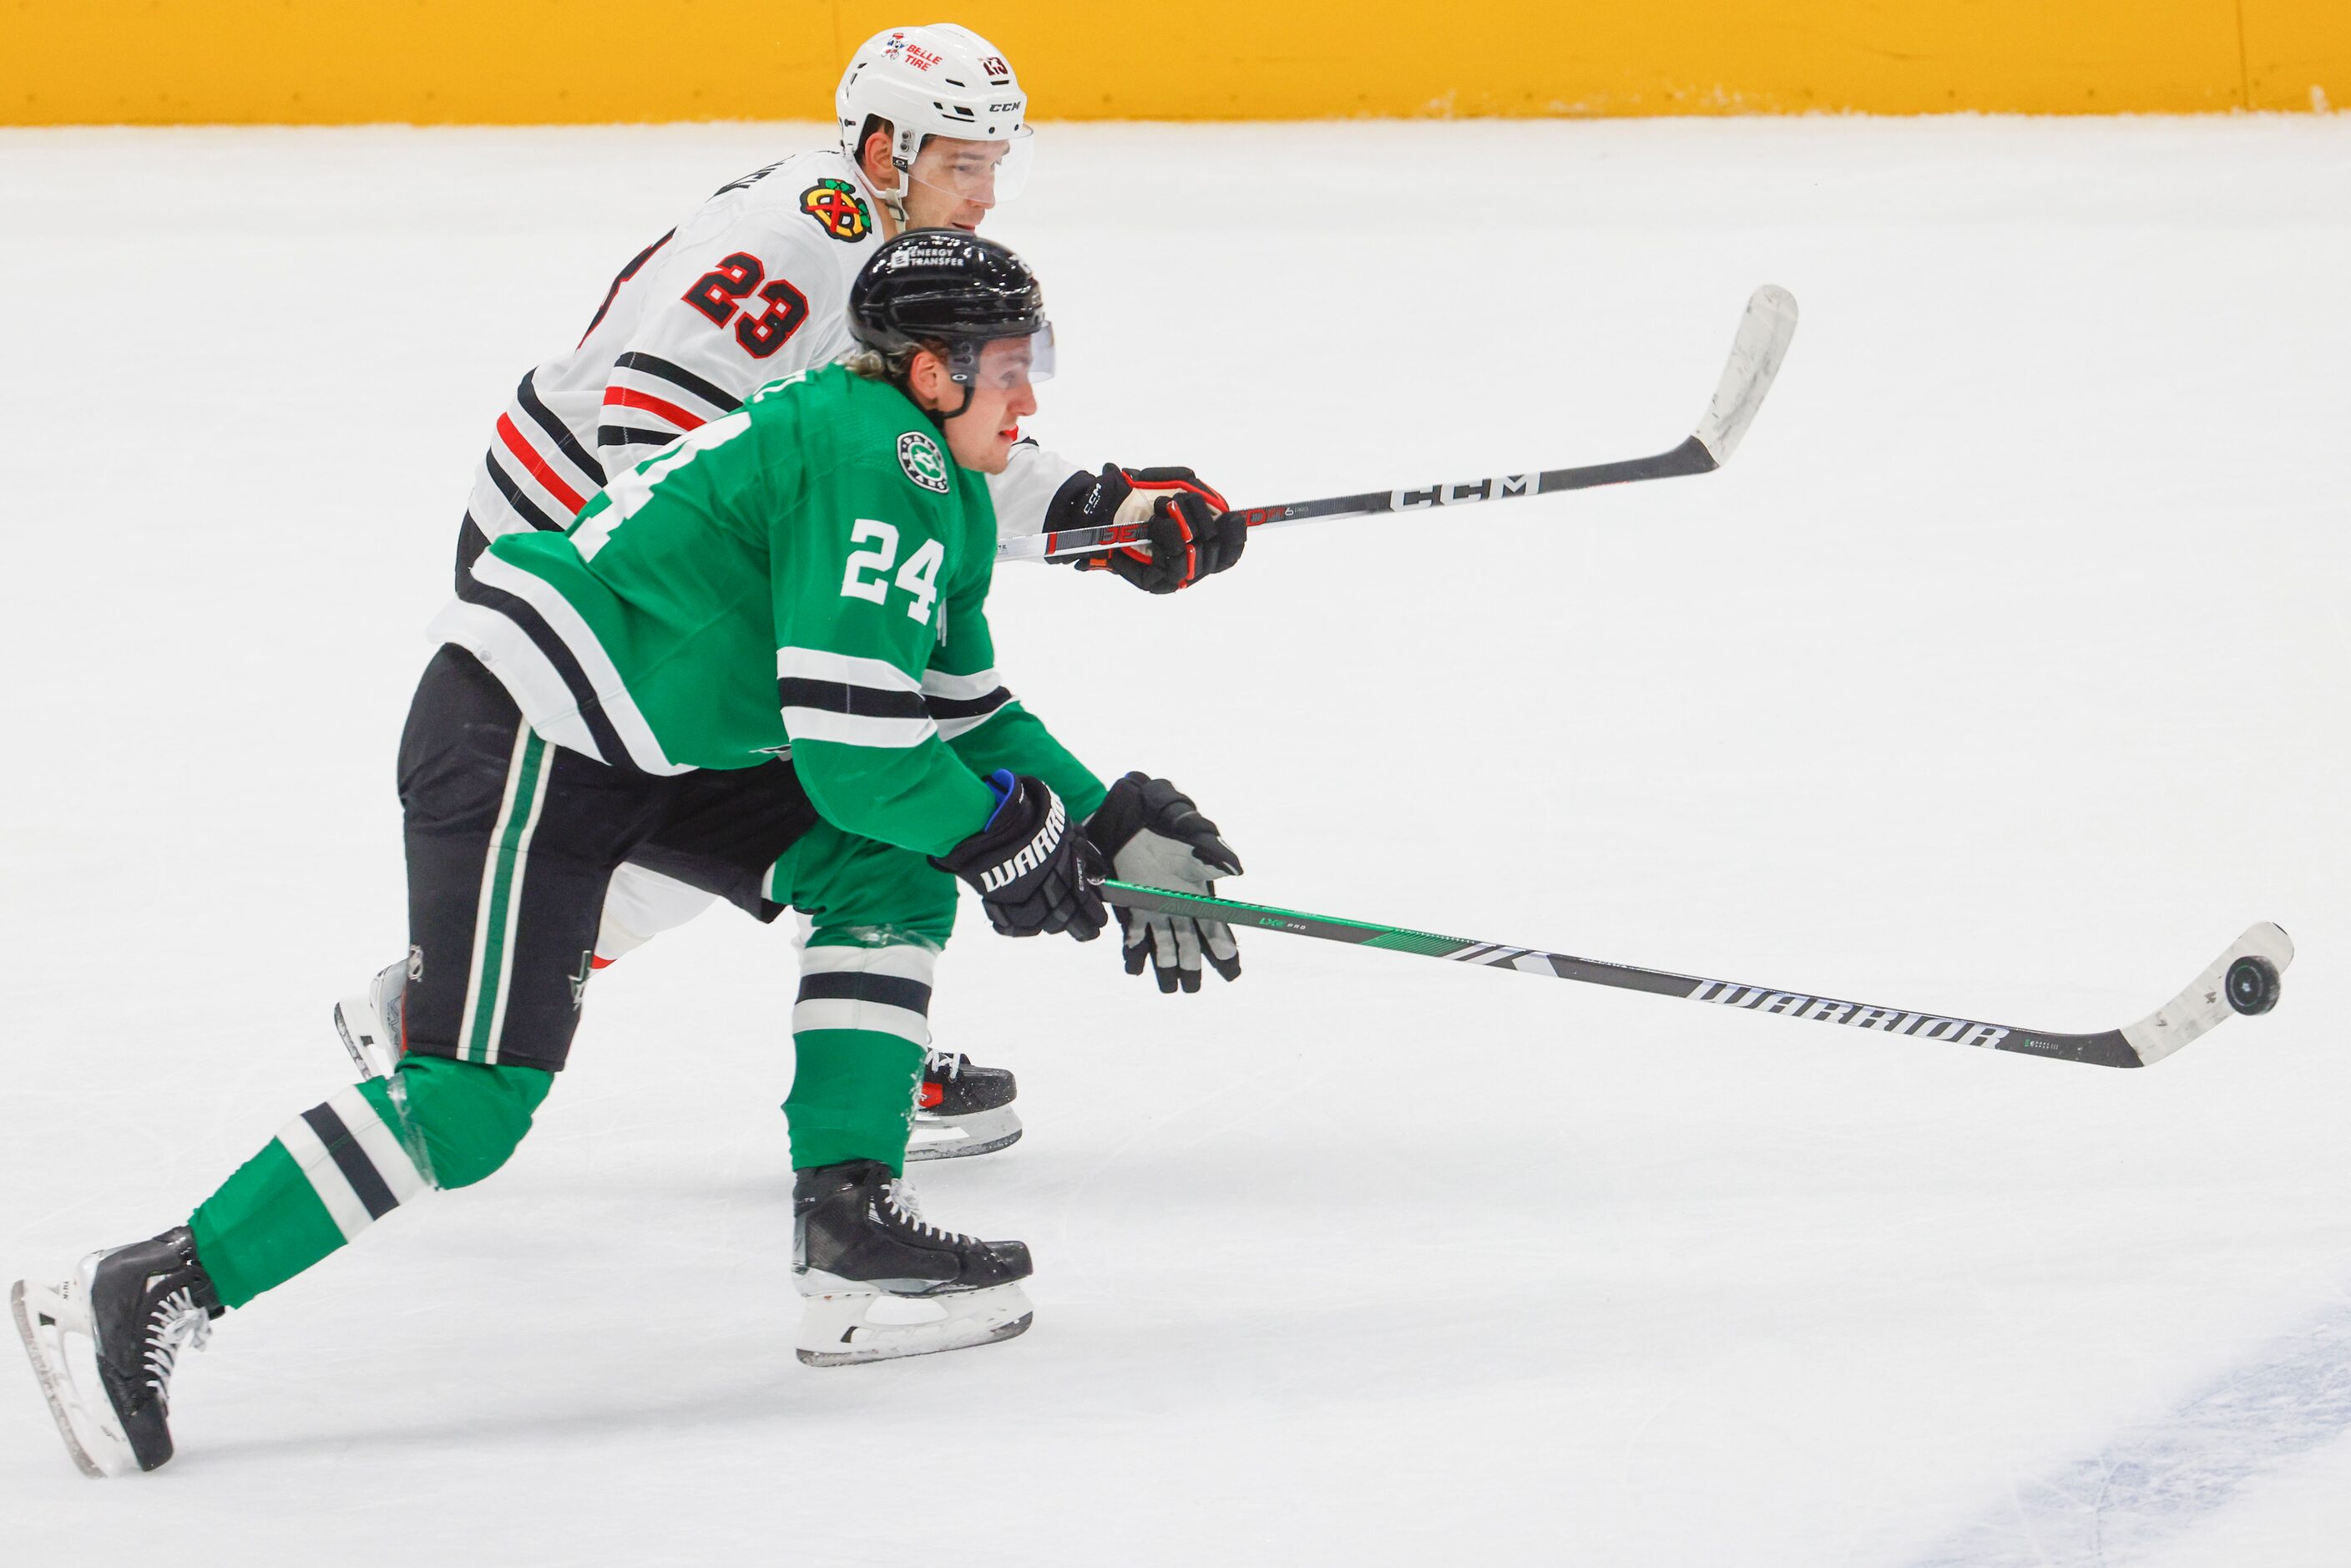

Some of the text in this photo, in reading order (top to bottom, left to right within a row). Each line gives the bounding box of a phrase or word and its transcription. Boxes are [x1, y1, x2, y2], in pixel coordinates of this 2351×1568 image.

[905, 54, 931, 72] TIRE
[906, 44, 943, 65] BELLE
[988, 101, 1021, 112] CCM
[909, 257, 964, 266] TRANSFER
[910, 249, 953, 257] ENERGY
[680, 251, 810, 359] 23
[1083, 483, 1102, 515] CCM
[1390, 471, 1541, 513] CCM
[840, 518, 945, 625] 24
[1287, 923, 1307, 931] PRO
[1686, 980, 2010, 1050] WARRIOR
